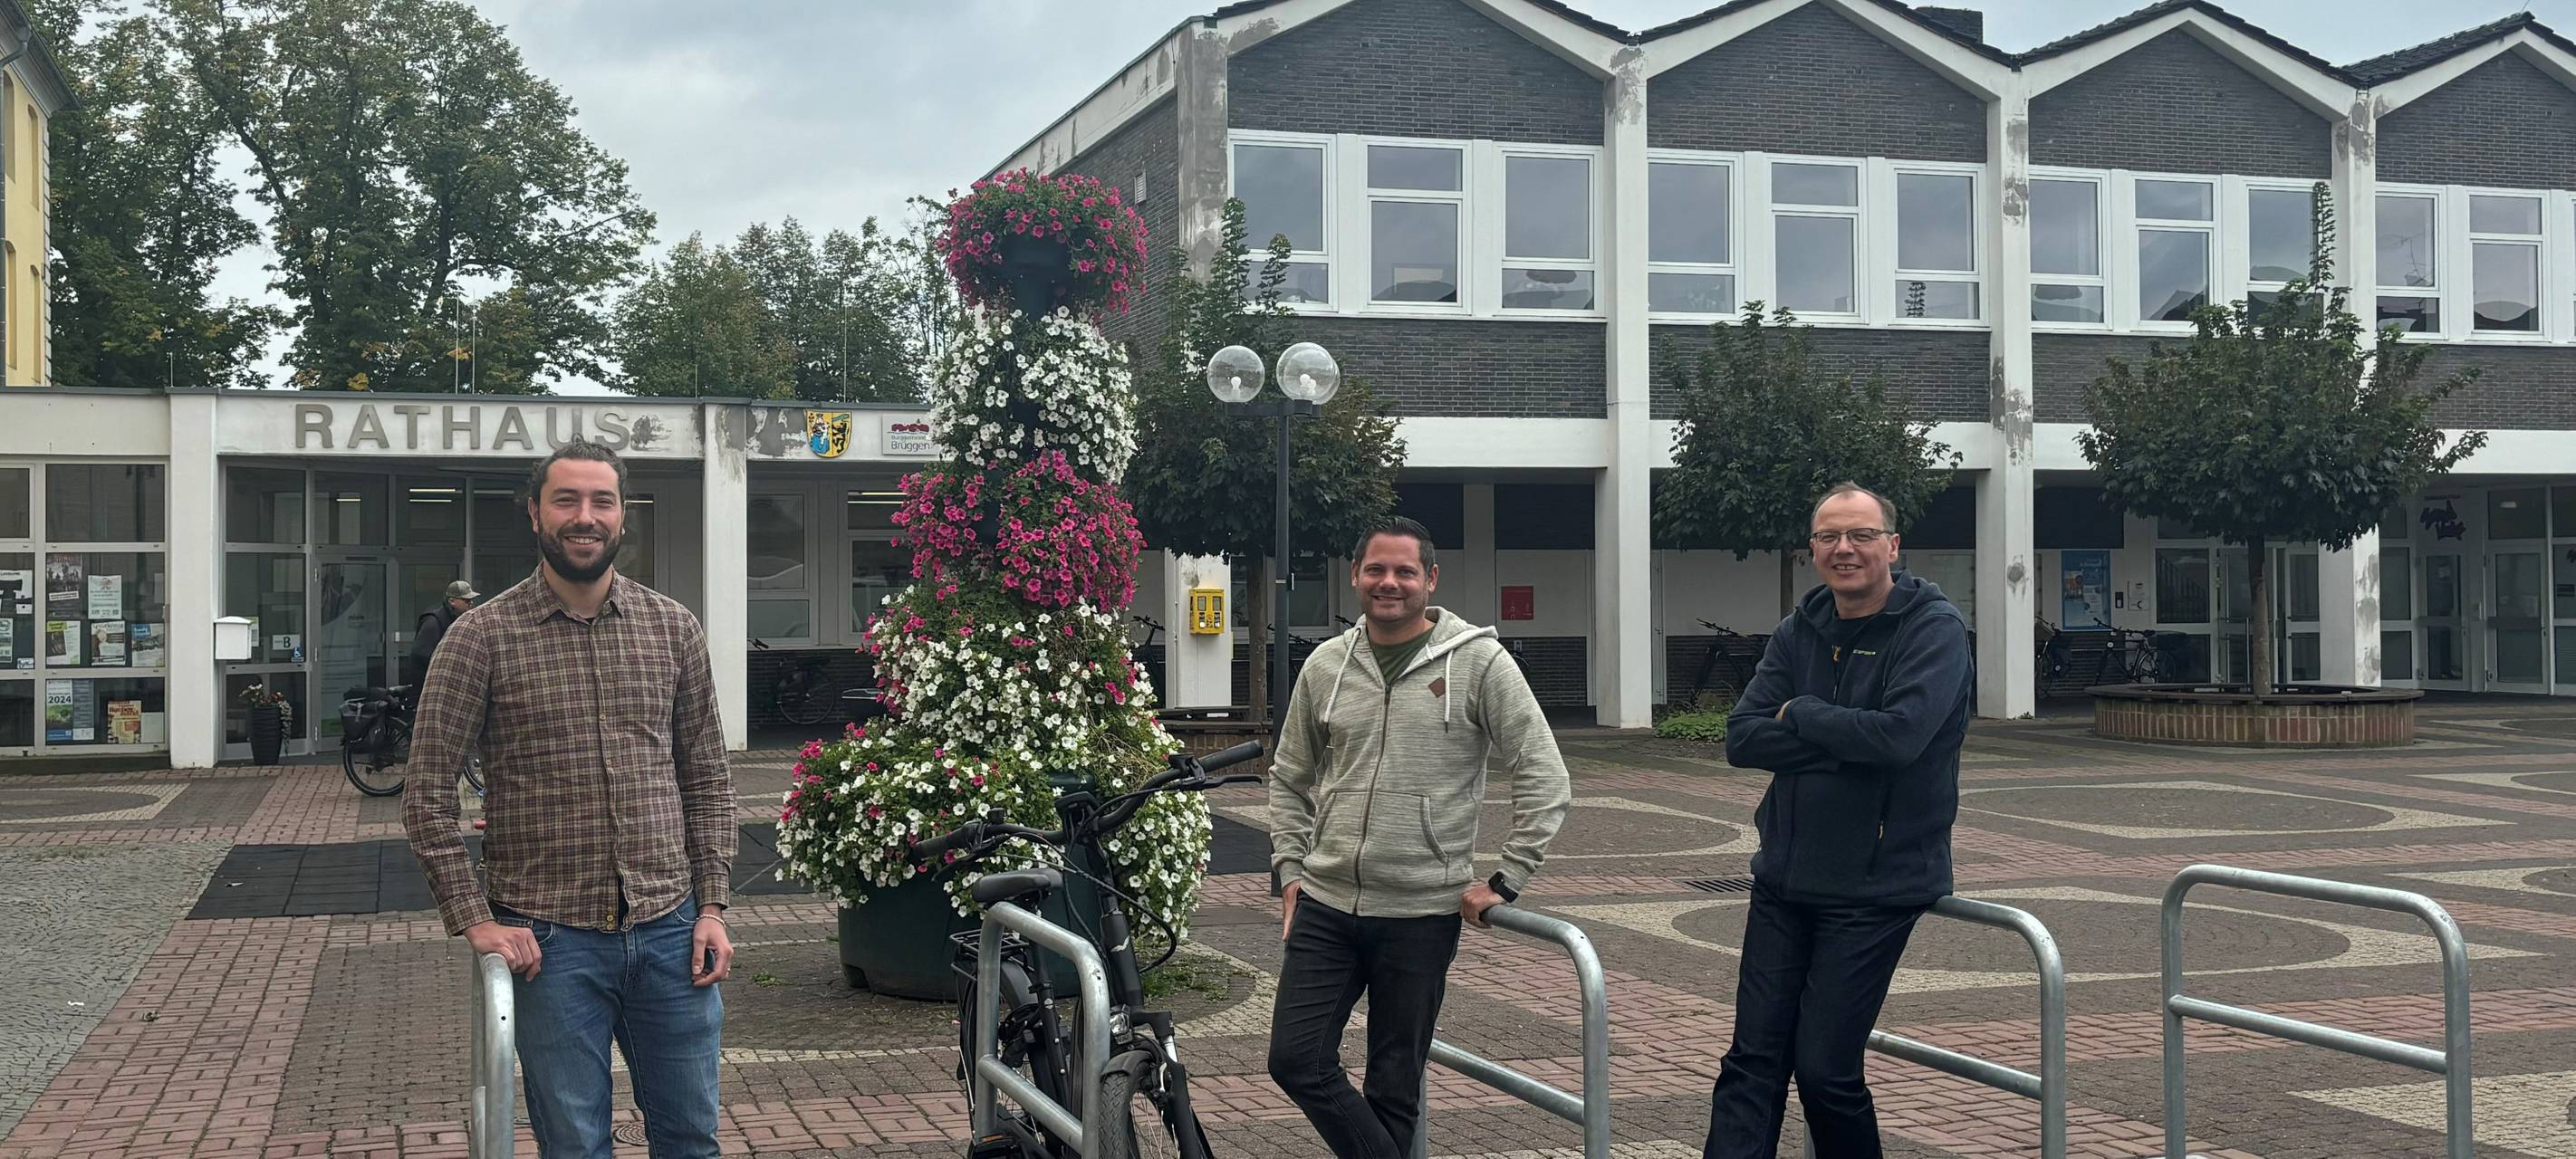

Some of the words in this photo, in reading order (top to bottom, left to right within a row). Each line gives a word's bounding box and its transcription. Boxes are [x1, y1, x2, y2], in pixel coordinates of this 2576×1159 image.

[295, 403, 630, 451] RATHAUS
[283, 636, 291, 648] B
[48, 695, 72, 704] 2024
